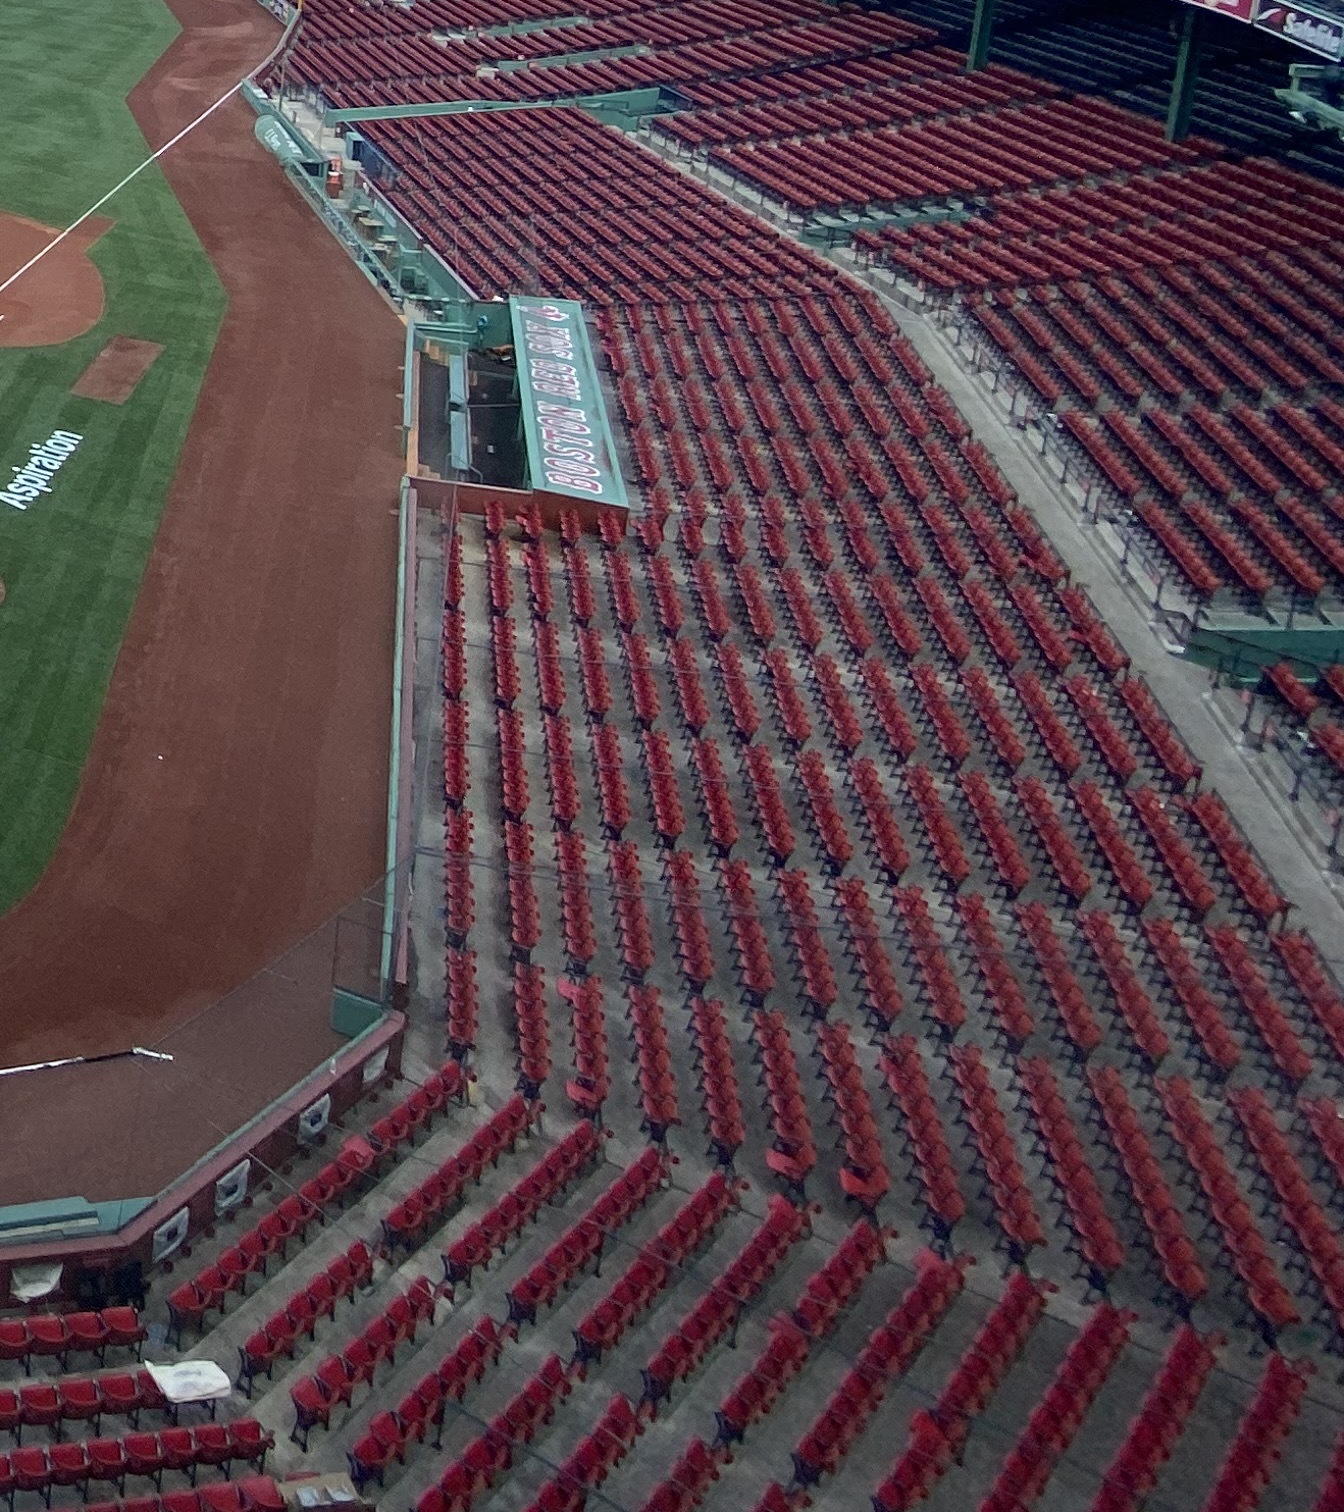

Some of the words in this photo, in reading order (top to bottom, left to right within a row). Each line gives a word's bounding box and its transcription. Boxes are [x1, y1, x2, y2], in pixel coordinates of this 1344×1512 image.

[525, 319, 573, 360] SOX
[529, 358, 581, 401] RED
[537, 400, 603, 495] BOSTON
